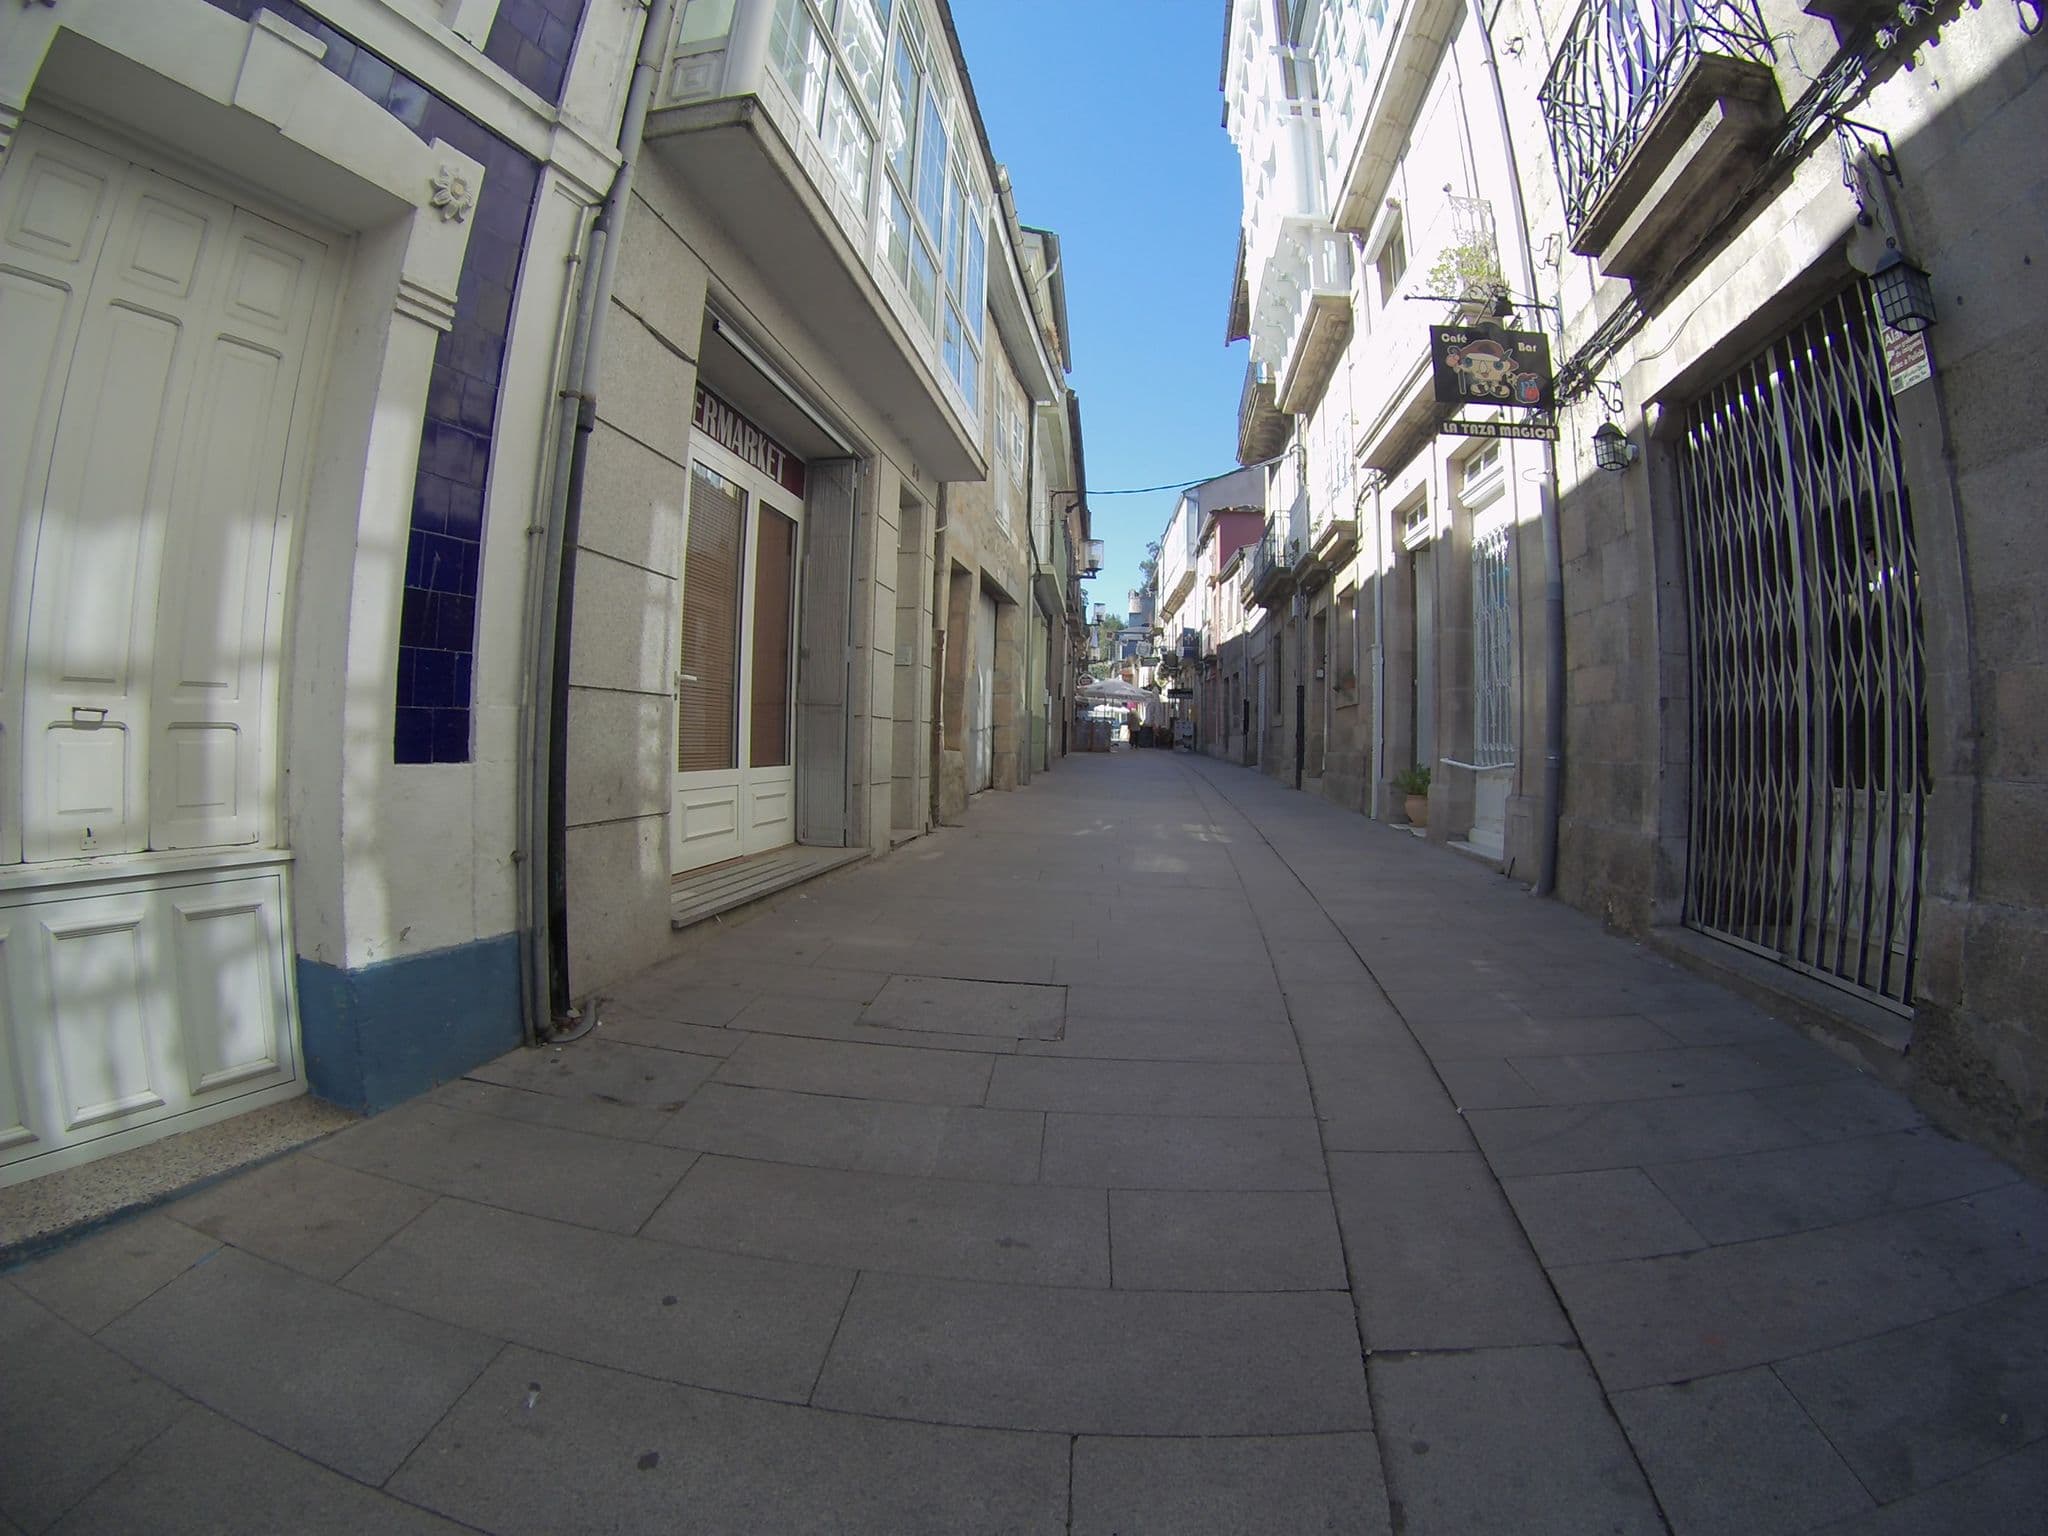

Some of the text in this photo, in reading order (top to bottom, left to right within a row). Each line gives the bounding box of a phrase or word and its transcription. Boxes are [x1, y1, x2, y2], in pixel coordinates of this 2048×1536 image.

[1441, 333, 1468, 343] Café
[1518, 342, 1537, 353] Bar
[693, 387, 786, 484] ERMARKET
[1443, 422, 1556, 439] LA TAZA MAGICA
